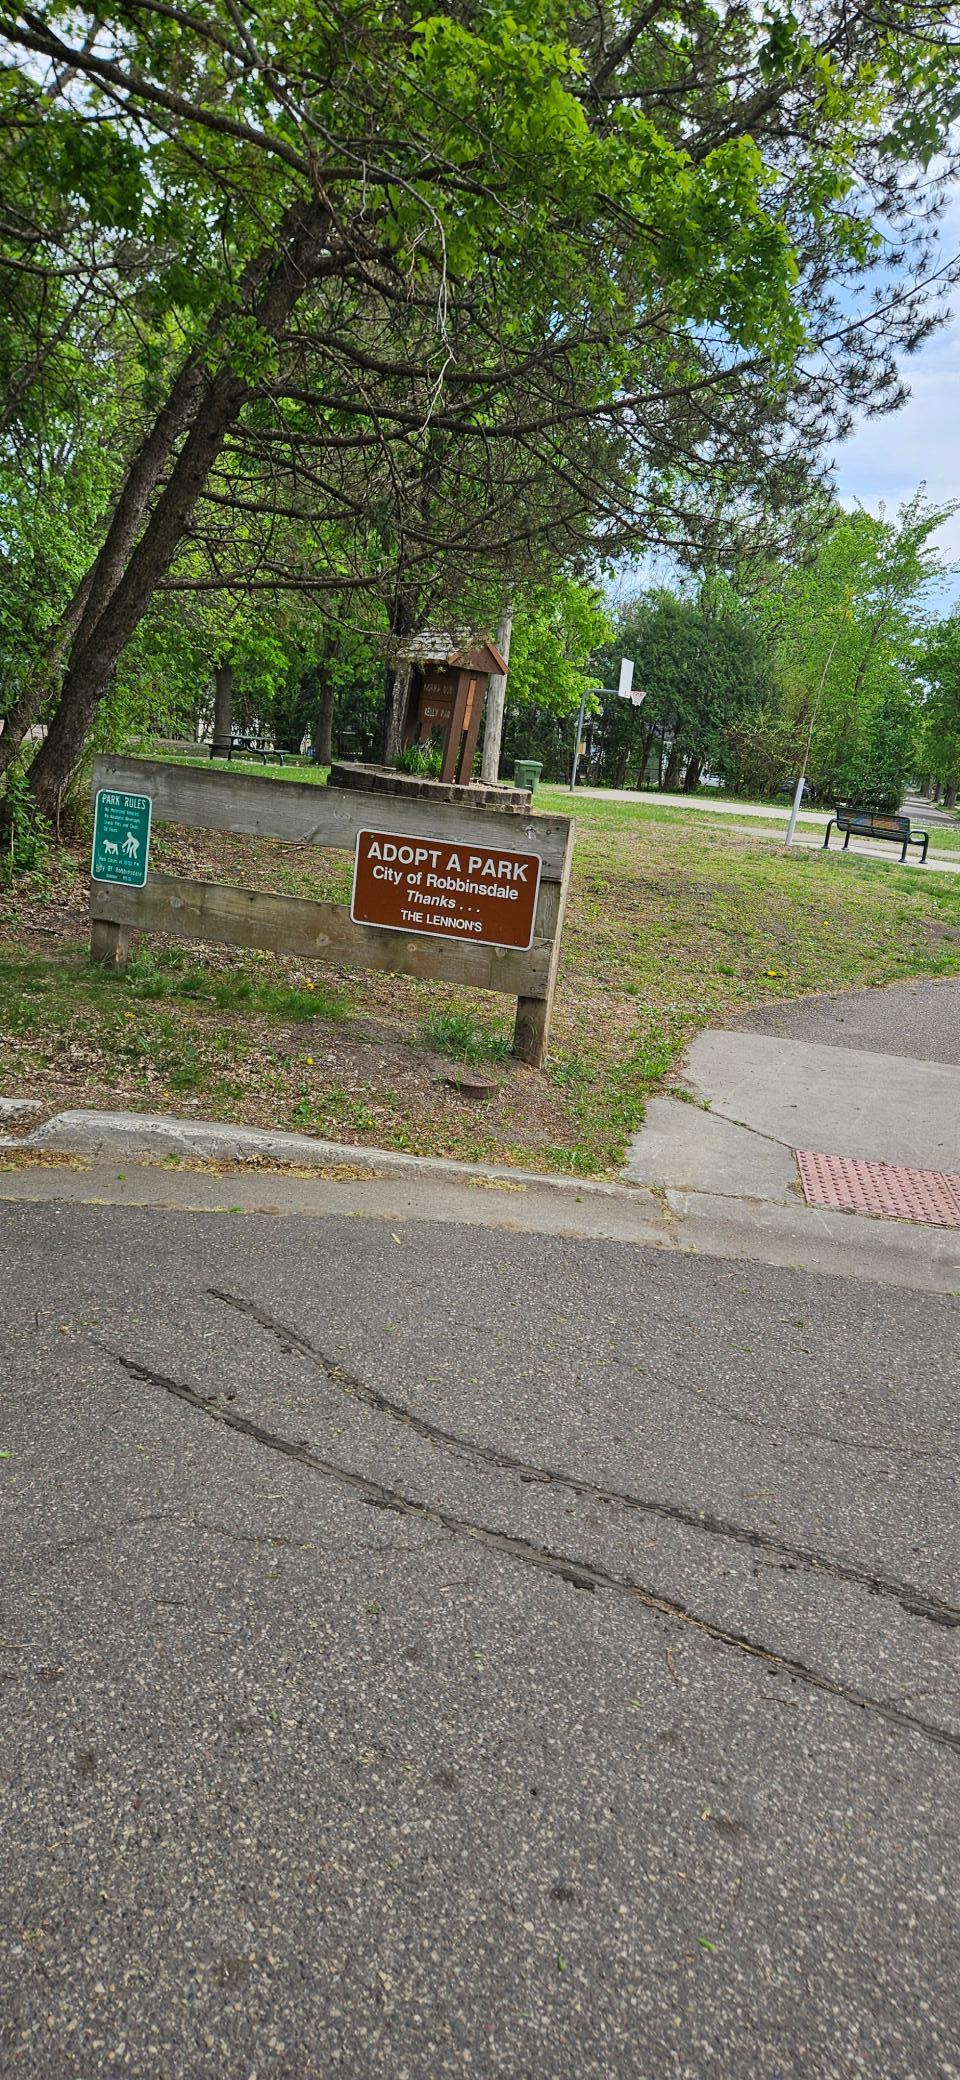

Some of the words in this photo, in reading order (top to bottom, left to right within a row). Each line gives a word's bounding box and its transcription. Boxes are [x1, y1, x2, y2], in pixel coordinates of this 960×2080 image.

[102, 793, 120, 806] PARK
[124, 796, 146, 810] RULES
[367, 841, 442, 868] ADOPT
[446, 853, 461, 872] A
[468, 856, 528, 882] PARK
[373, 865, 402, 885] City
[407, 872, 422, 885] of
[426, 873, 519, 900] Robbinsdale
[407, 889, 456, 909] Thanks
[401, 909, 423, 923] THE
[426, 913, 482, 932] LENNON'S
